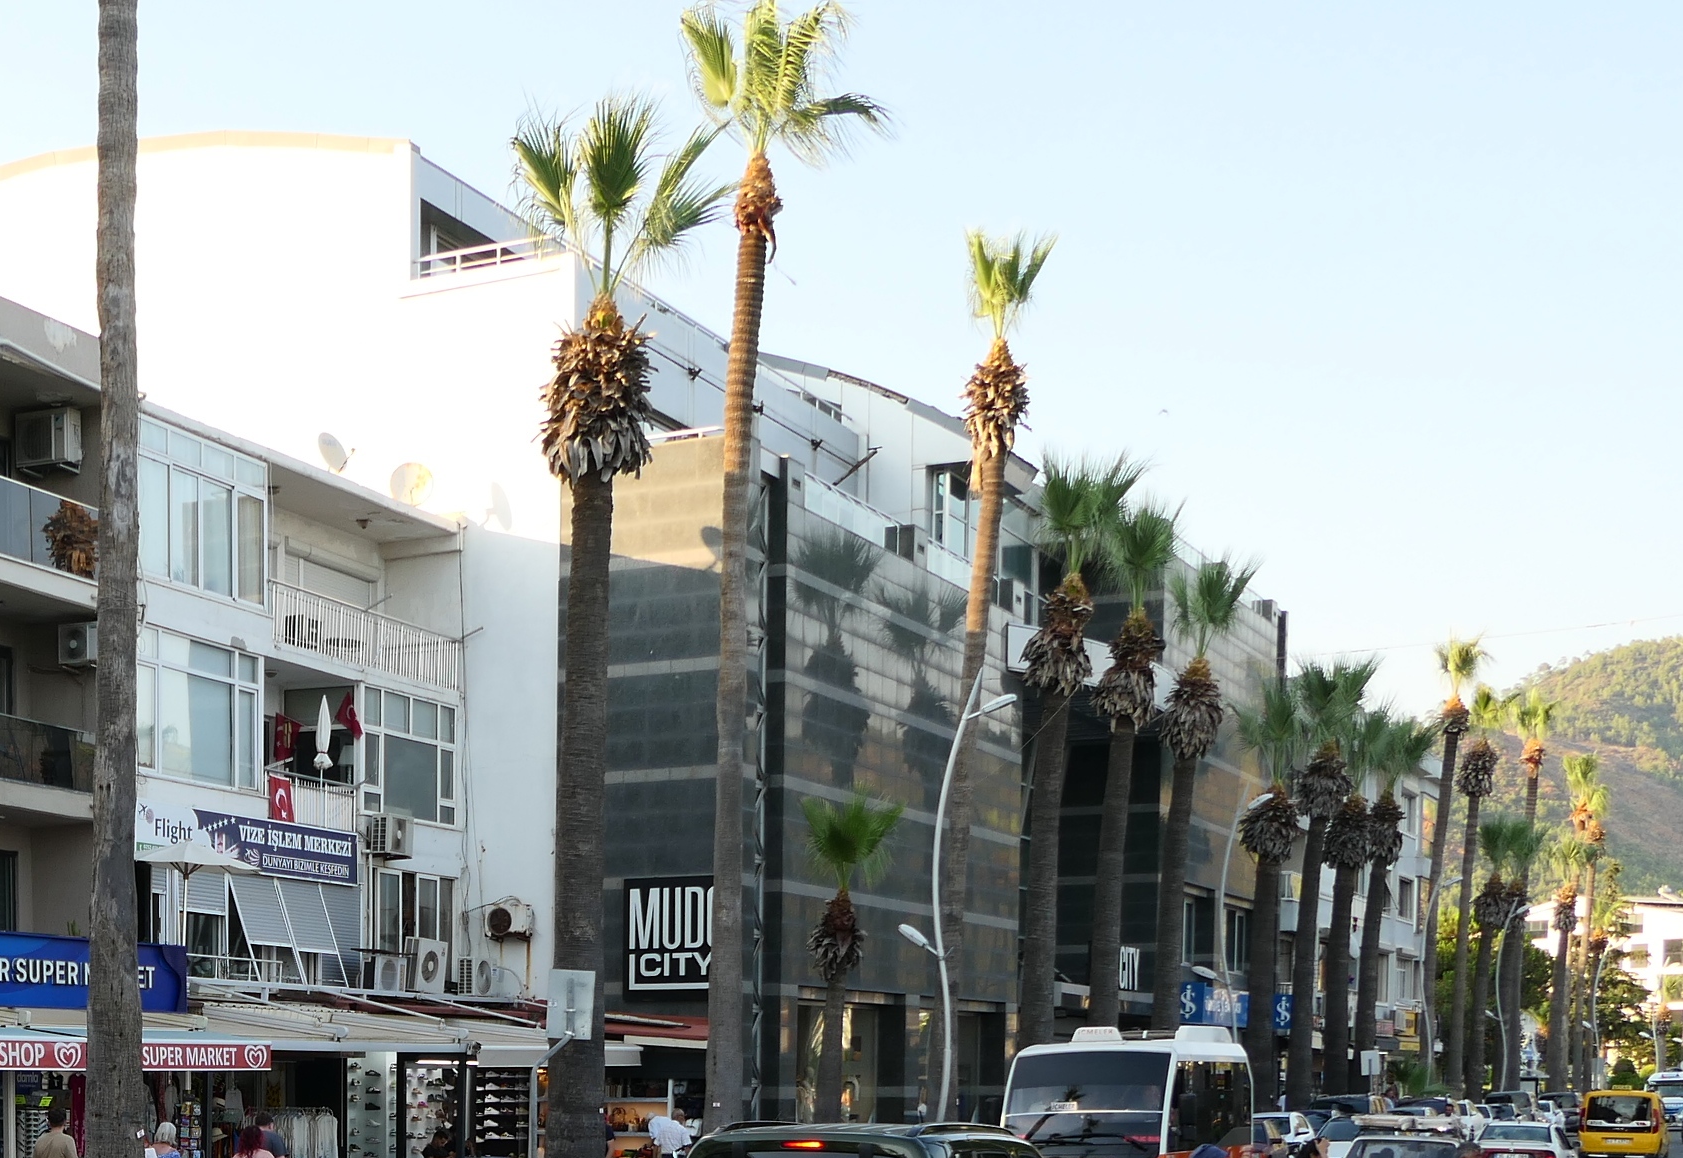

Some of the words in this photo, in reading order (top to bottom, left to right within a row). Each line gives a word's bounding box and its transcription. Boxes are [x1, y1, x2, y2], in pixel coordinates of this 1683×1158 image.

[154, 818, 193, 844] Flight
[238, 821, 265, 845] VİZE
[267, 824, 303, 852] İŞLEM
[303, 836, 353, 858] MERKEZİ
[15, 958, 78, 986] SUPER
[639, 952, 712, 977] CITY
[1119, 946, 1140, 990] CITY
[142, 1045, 183, 1066] SUPER
[186, 1047, 237, 1067] MARKET
